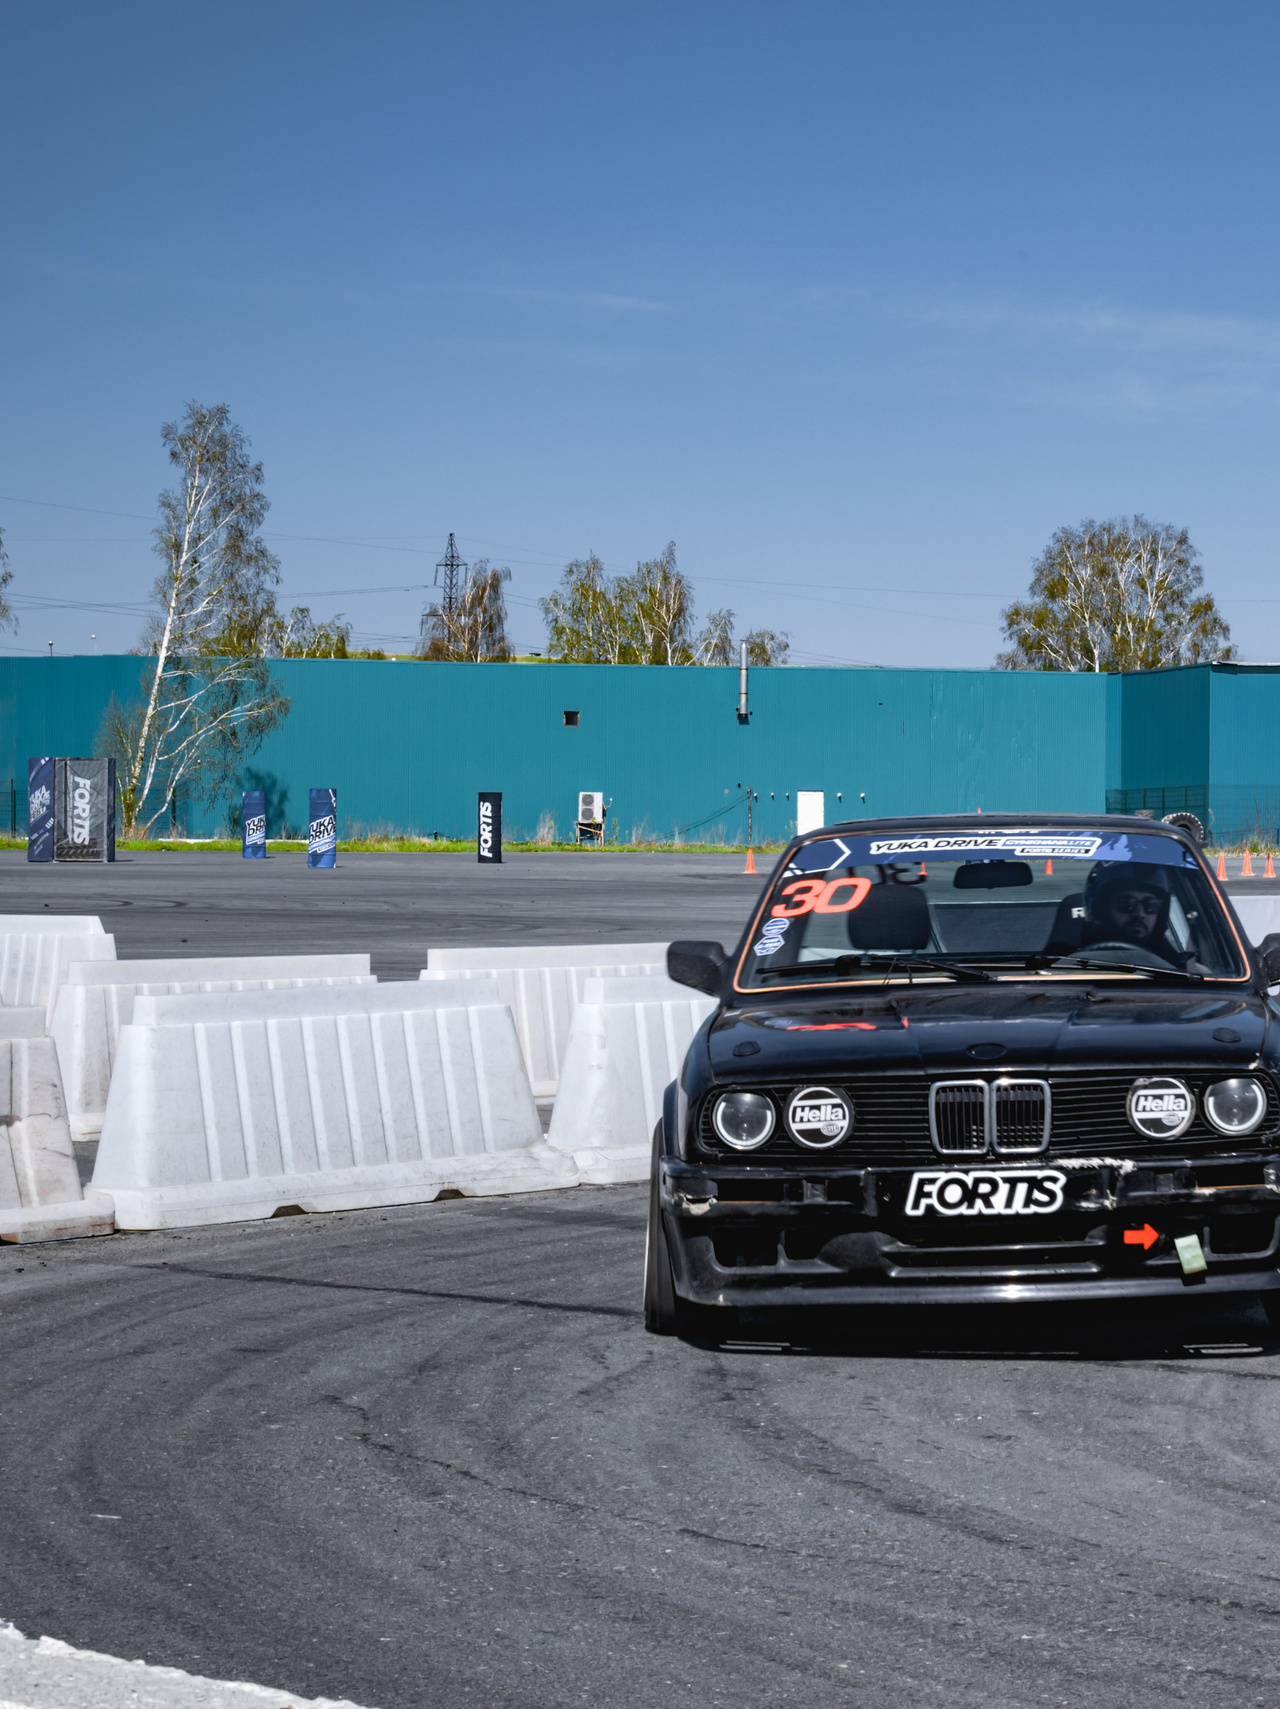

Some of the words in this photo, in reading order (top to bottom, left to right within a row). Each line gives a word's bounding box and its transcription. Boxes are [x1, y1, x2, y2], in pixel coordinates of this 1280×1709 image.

[74, 776, 90, 845] FORTIS
[480, 801, 492, 857] FORTIS
[875, 841, 929, 851] YUKA
[933, 839, 1001, 848] DRIVE
[771, 877, 872, 918] 30
[795, 1104, 843, 1122] Hella
[1137, 1094, 1185, 1111] Hella
[908, 1173, 1064, 1212] FORTIS
